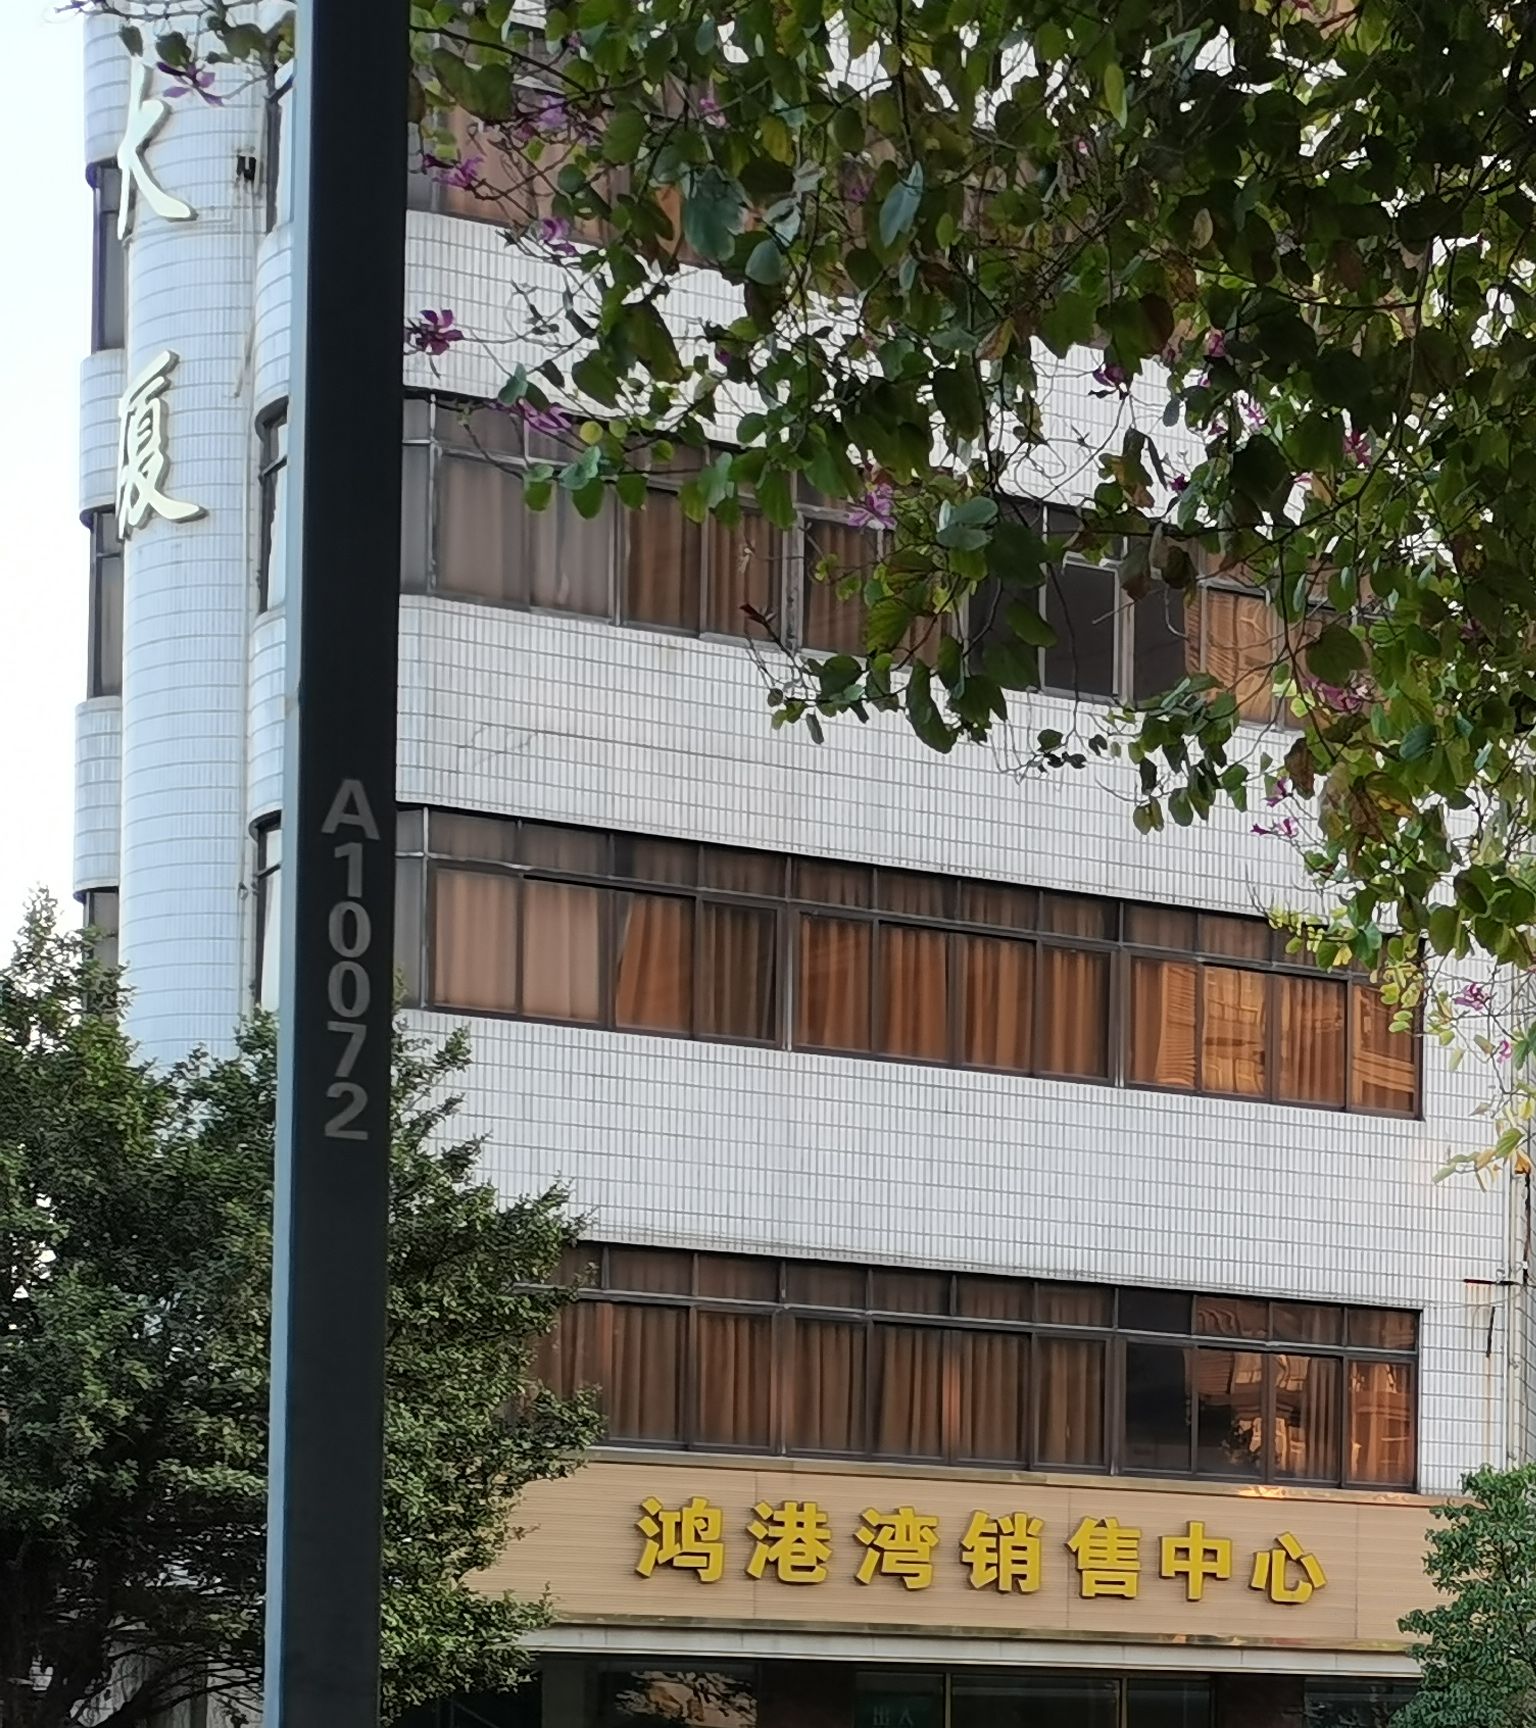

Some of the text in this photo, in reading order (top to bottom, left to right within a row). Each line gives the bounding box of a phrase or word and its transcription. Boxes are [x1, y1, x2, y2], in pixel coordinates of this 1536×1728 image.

[321, 778, 381, 1141] A10072
[634, 1495, 1327, 1605] 鸿港湾销售中心
